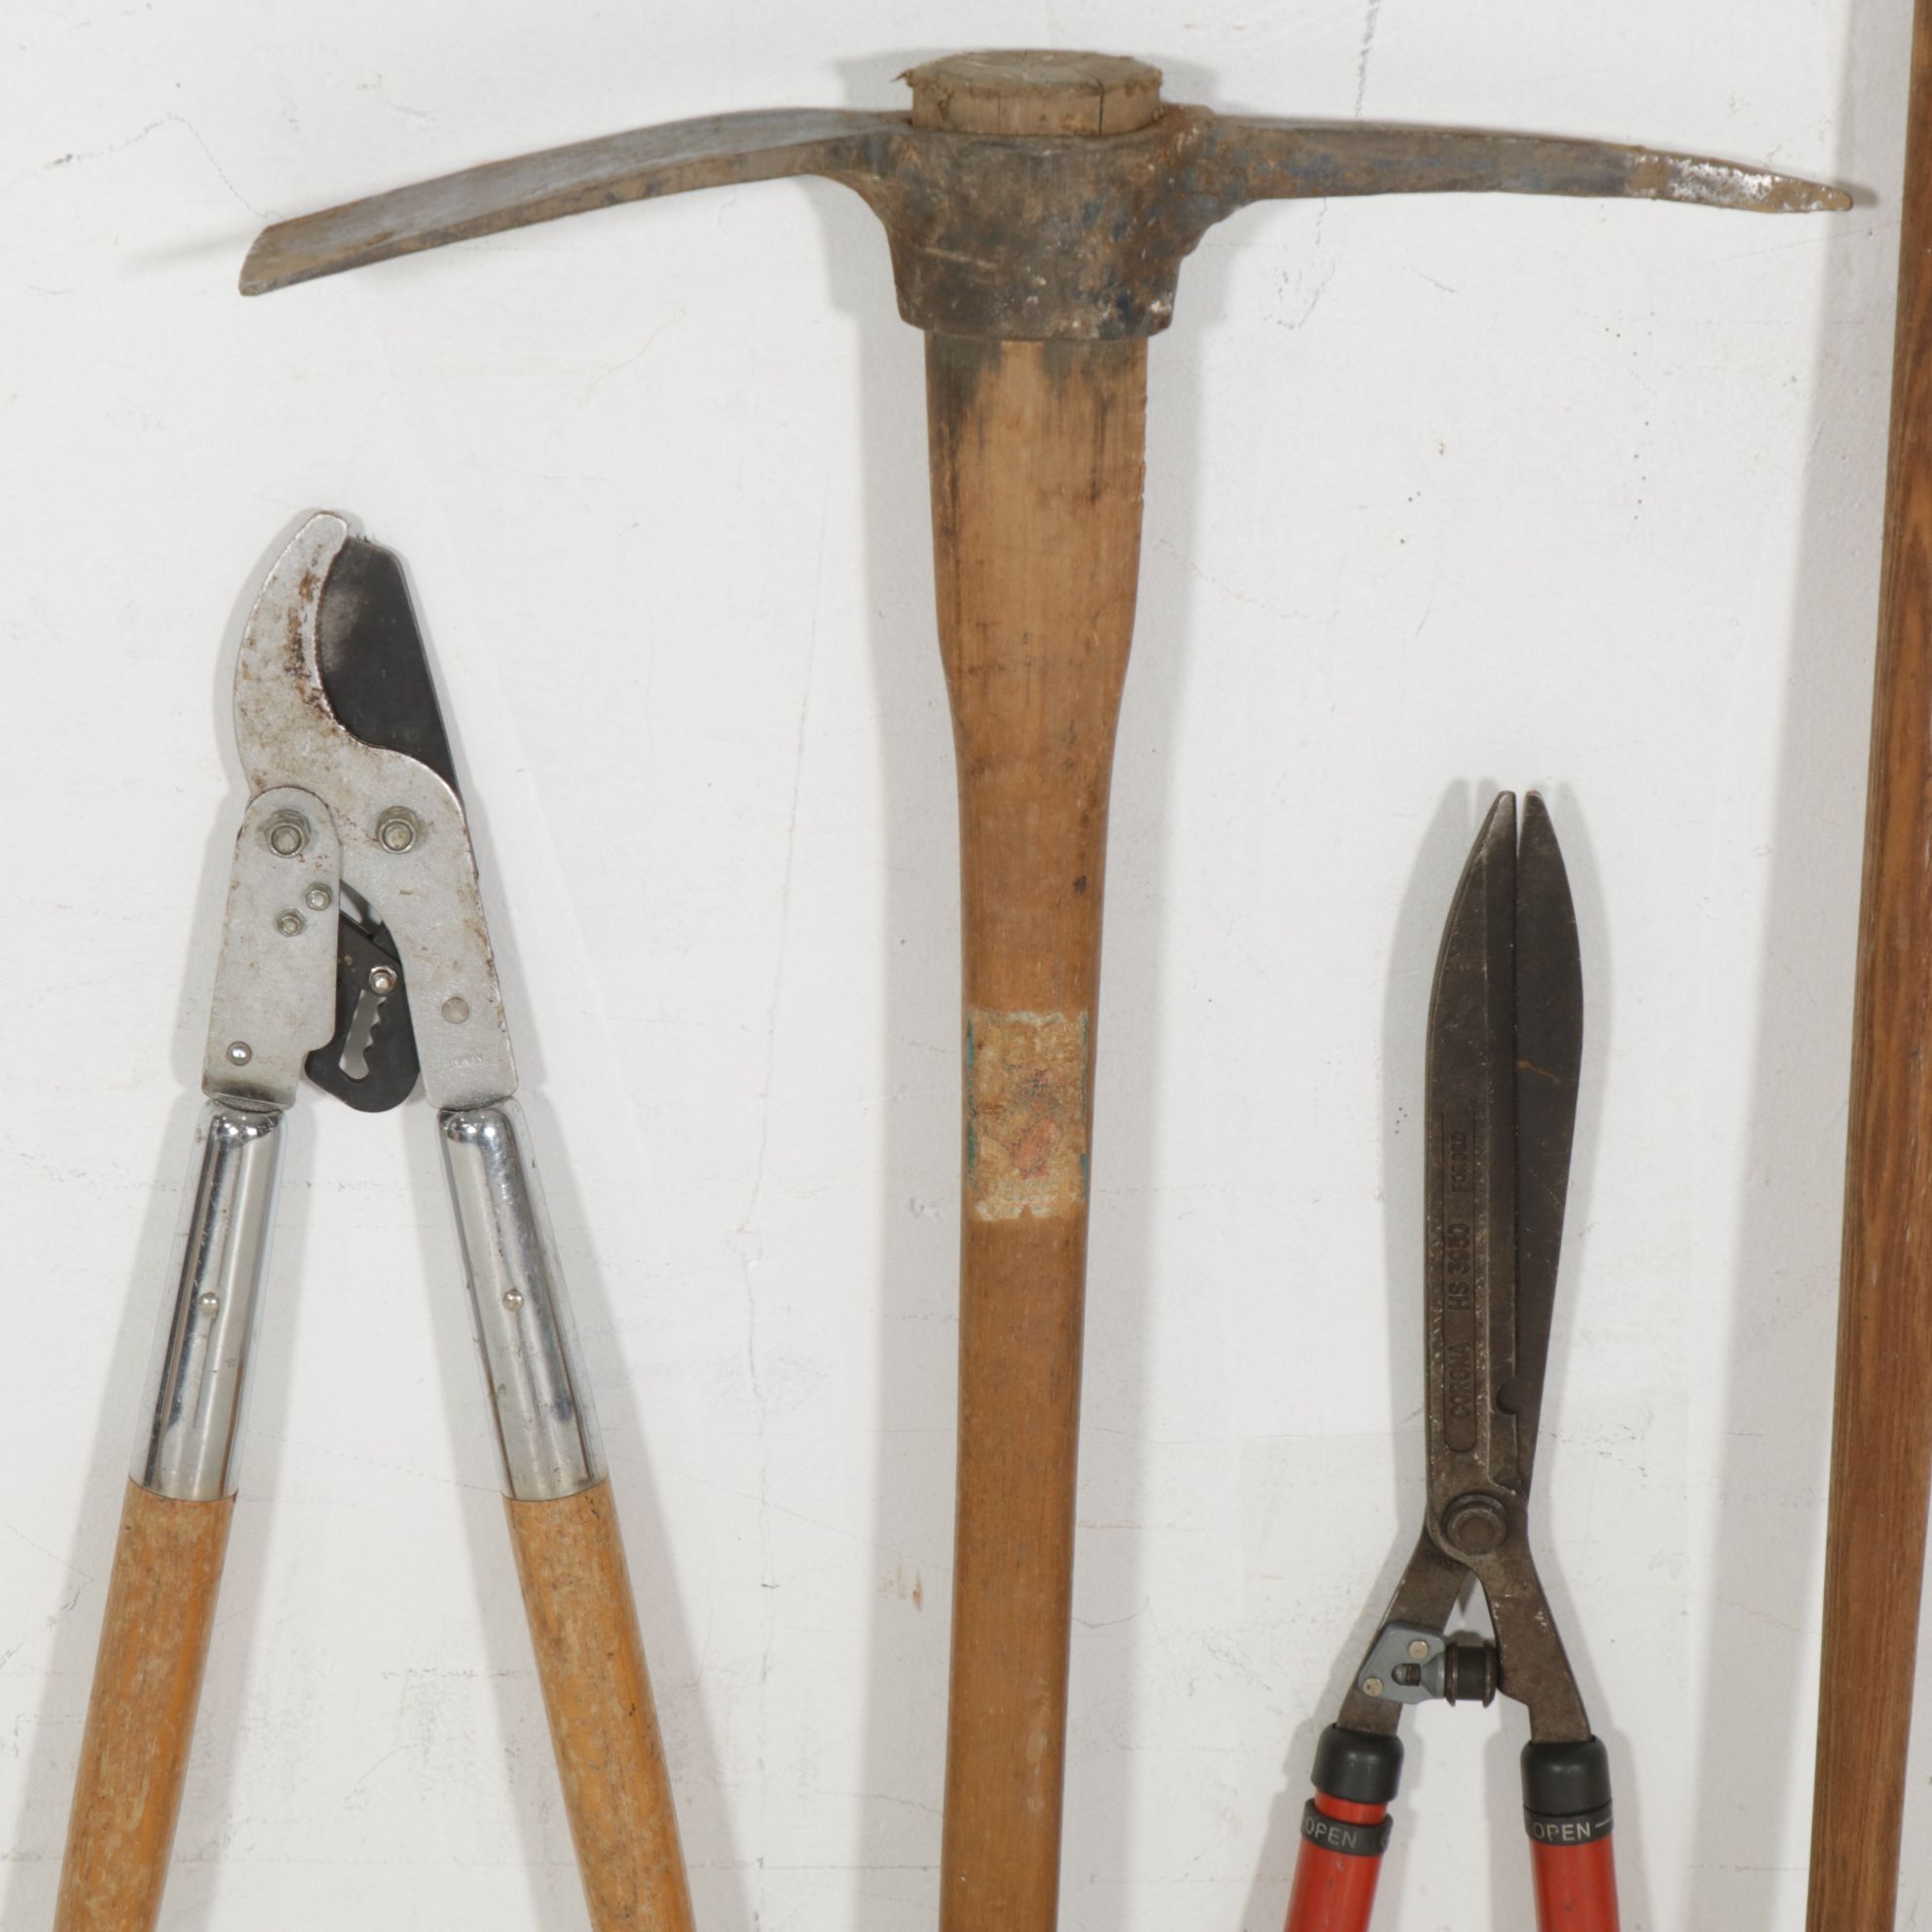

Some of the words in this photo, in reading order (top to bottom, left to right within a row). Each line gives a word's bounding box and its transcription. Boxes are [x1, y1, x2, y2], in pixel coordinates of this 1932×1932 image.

[1447, 1282, 1470, 1311] HS
[1447, 1341, 1470, 1419] CORONA
[1305, 1815, 1356, 1849] OPEN
[1534, 1821, 1591, 1841] OPEN
